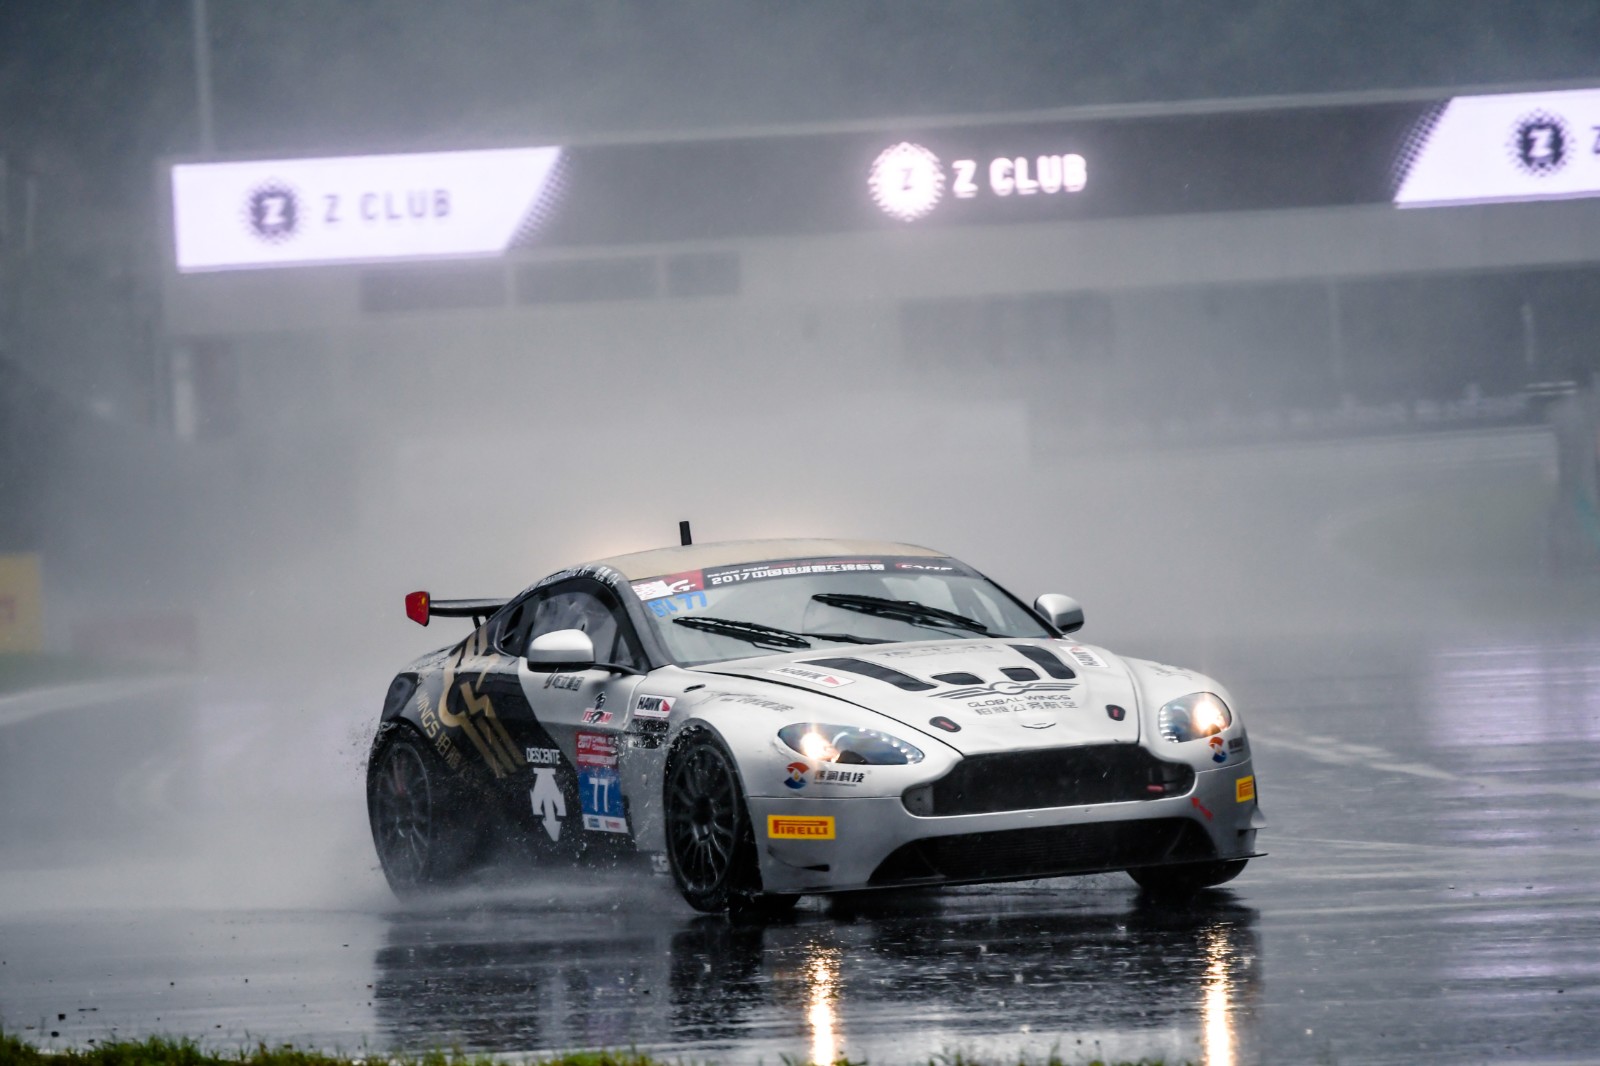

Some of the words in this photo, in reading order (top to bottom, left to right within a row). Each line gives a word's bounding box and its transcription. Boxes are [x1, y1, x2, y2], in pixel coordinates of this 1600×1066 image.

[952, 159, 979, 198] Z
[989, 153, 1088, 197] CLUB
[323, 194, 342, 223] Z
[360, 189, 451, 221] CLUB
[637, 696, 664, 711] HAWK
[967, 696, 1024, 708] GLOBAL
[526, 747, 561, 765] DESCENTE
[589, 776, 617, 813] 77
[773, 819, 829, 835] PIRELLI
